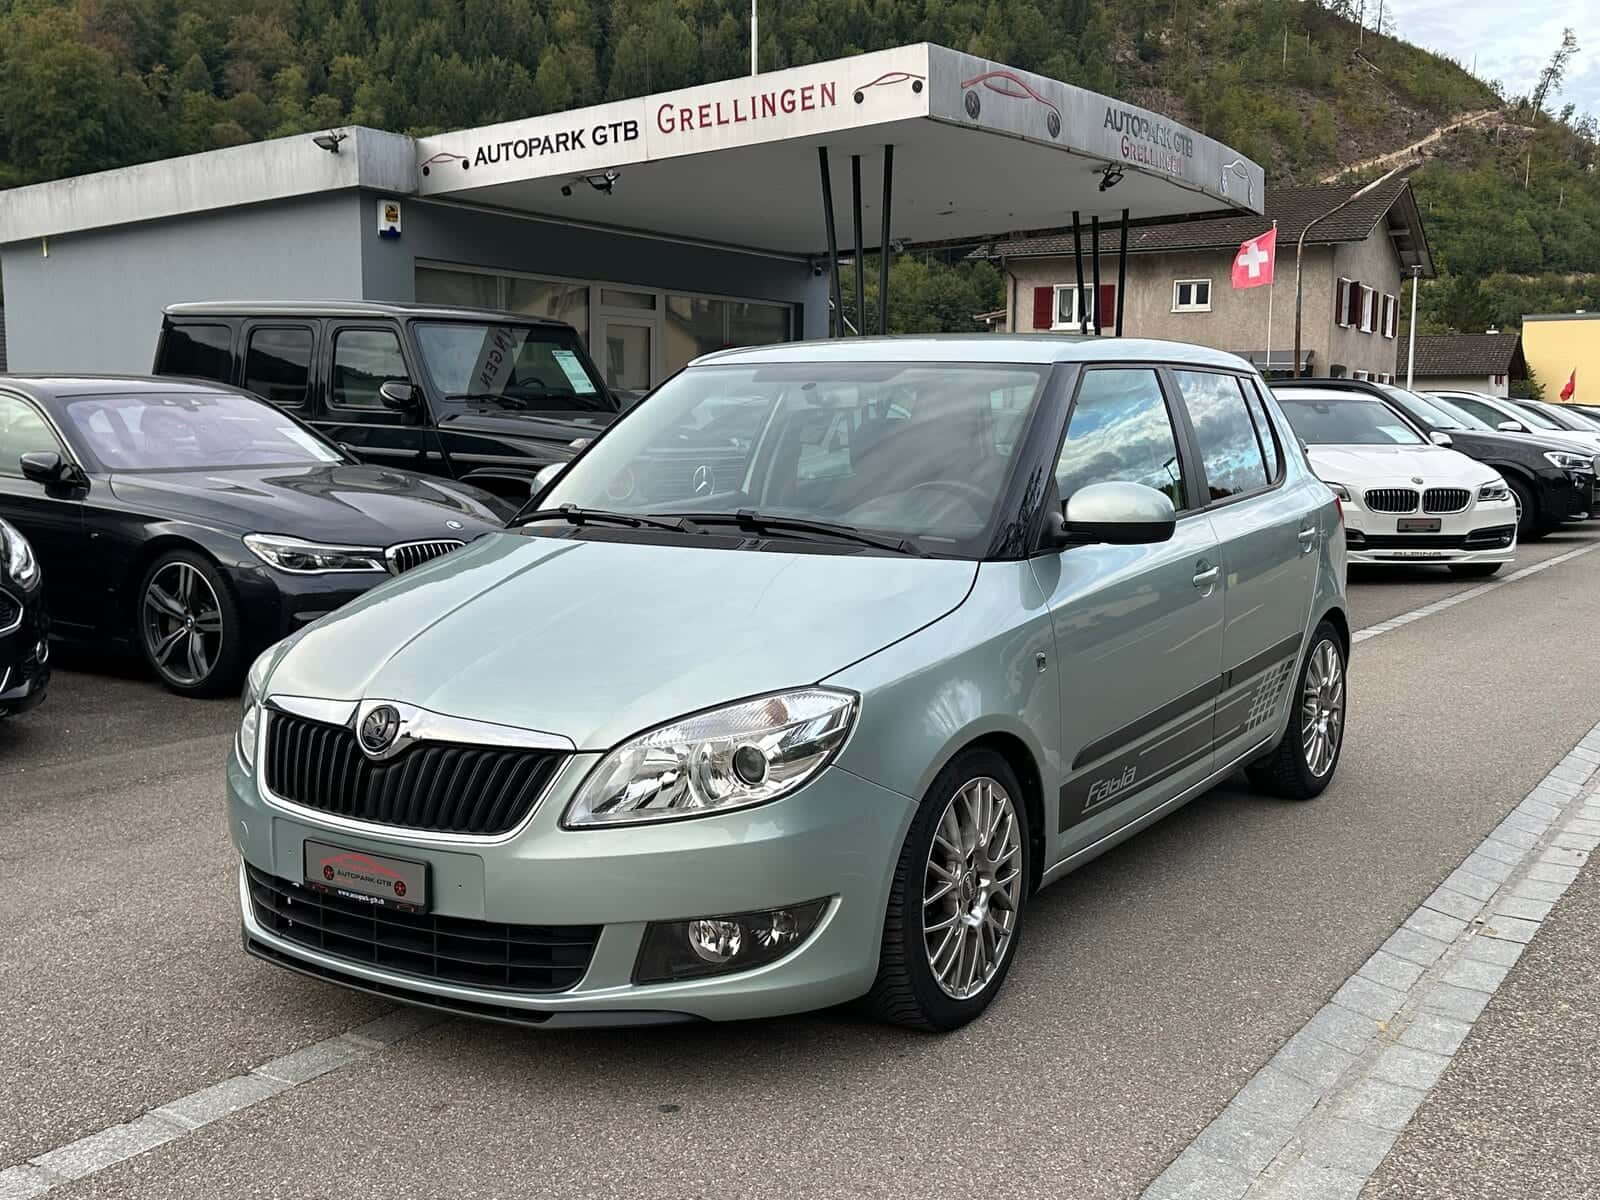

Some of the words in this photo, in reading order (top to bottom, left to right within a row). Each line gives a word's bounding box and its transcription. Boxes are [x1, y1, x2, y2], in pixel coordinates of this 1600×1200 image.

[474, 129, 585, 167] AUTOPARK
[592, 120, 639, 146] GTB
[1103, 106, 1172, 151] AUTOPARK
[1174, 132, 1193, 158] GTB
[1085, 766, 1137, 808] Fabia
